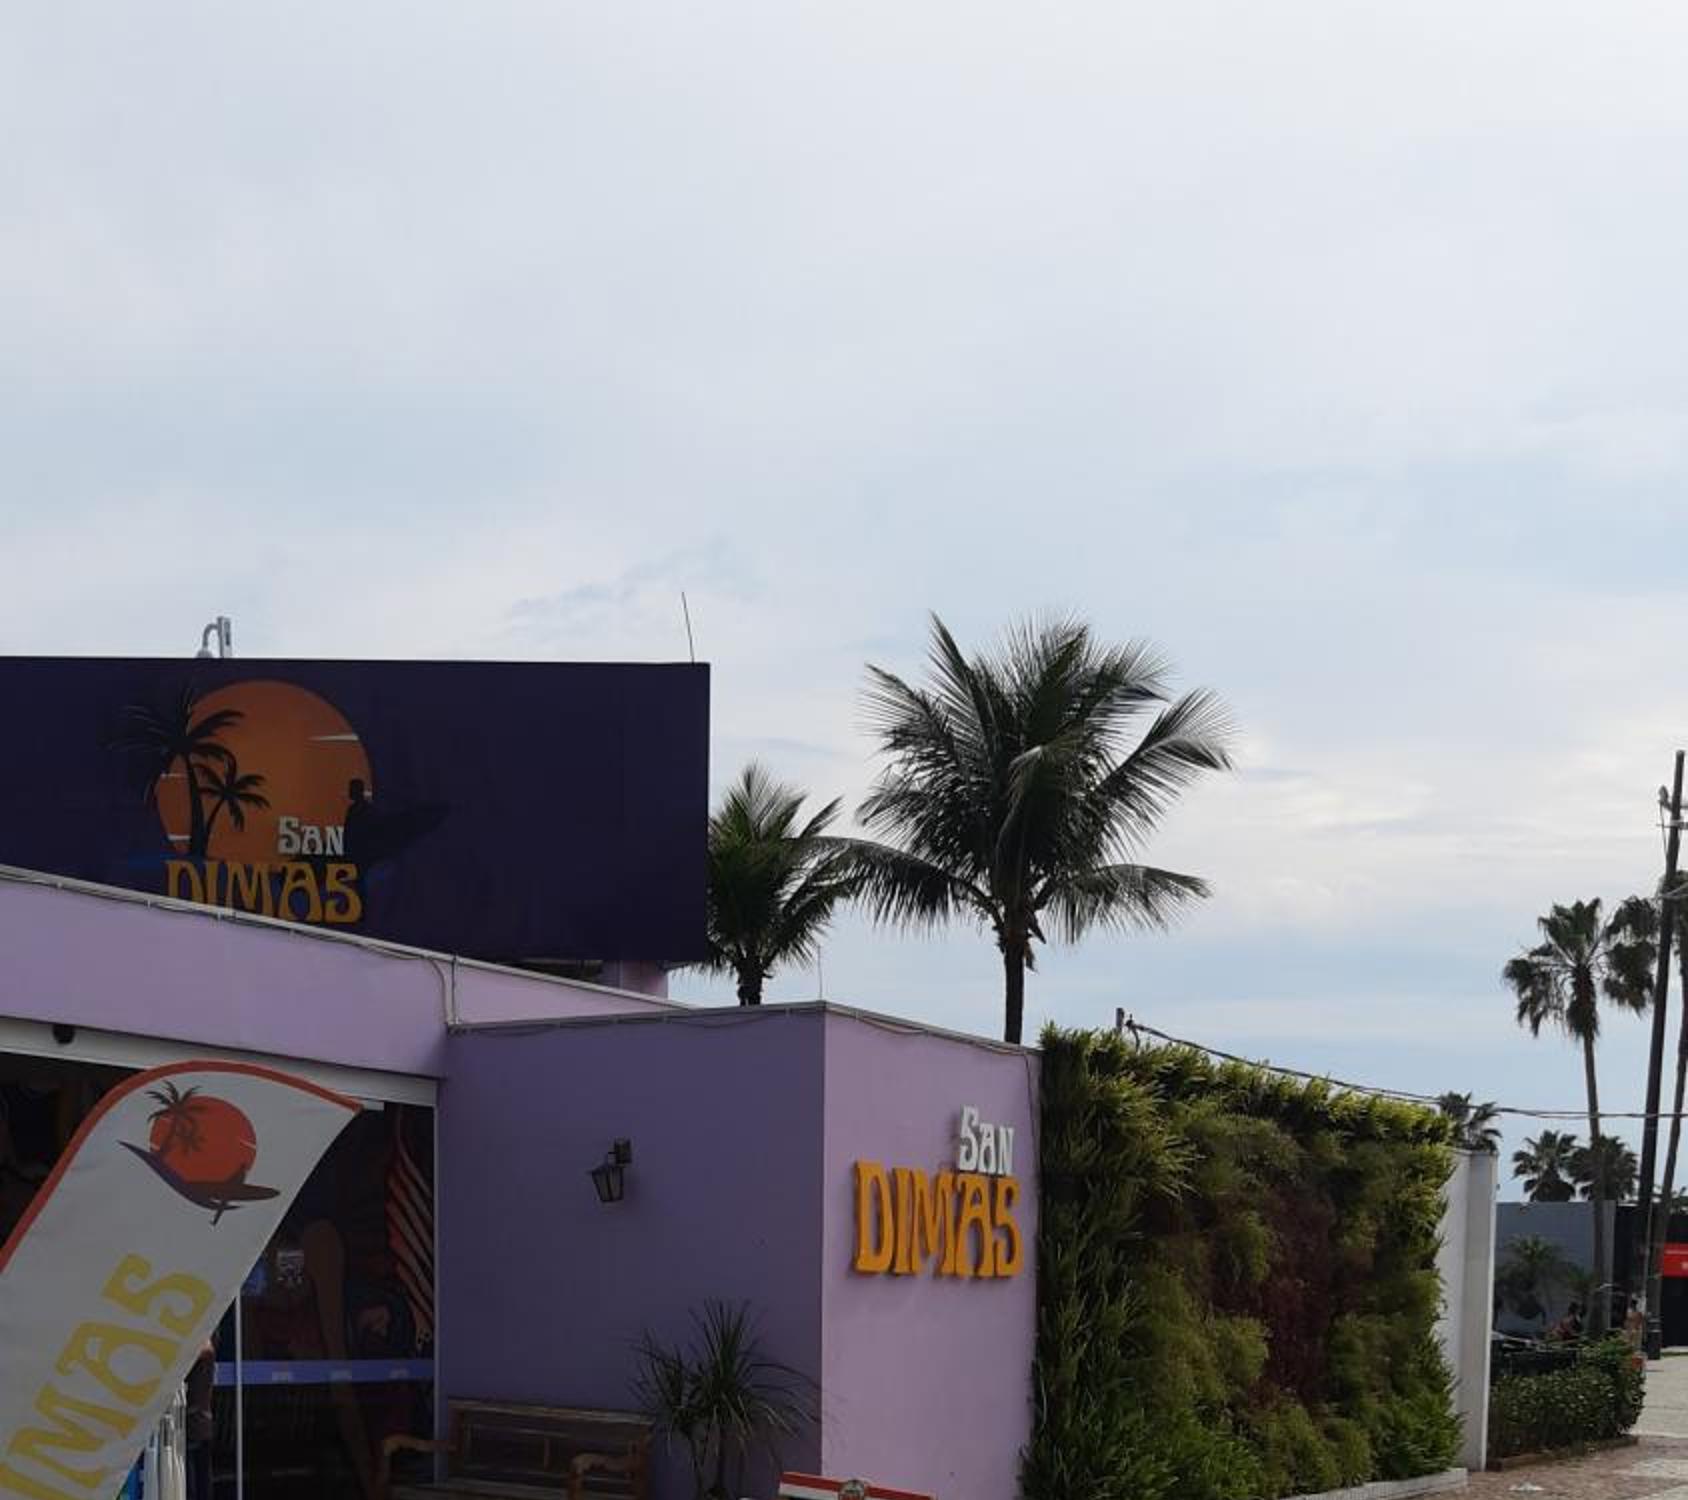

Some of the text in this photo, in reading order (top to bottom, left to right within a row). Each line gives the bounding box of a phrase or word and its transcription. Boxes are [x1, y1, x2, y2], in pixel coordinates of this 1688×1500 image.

[278, 815, 344, 856] SAN
[165, 860, 363, 923] DIMAS
[958, 1104, 1015, 1177] SAN
[854, 1160, 1025, 1278] DIMAS
